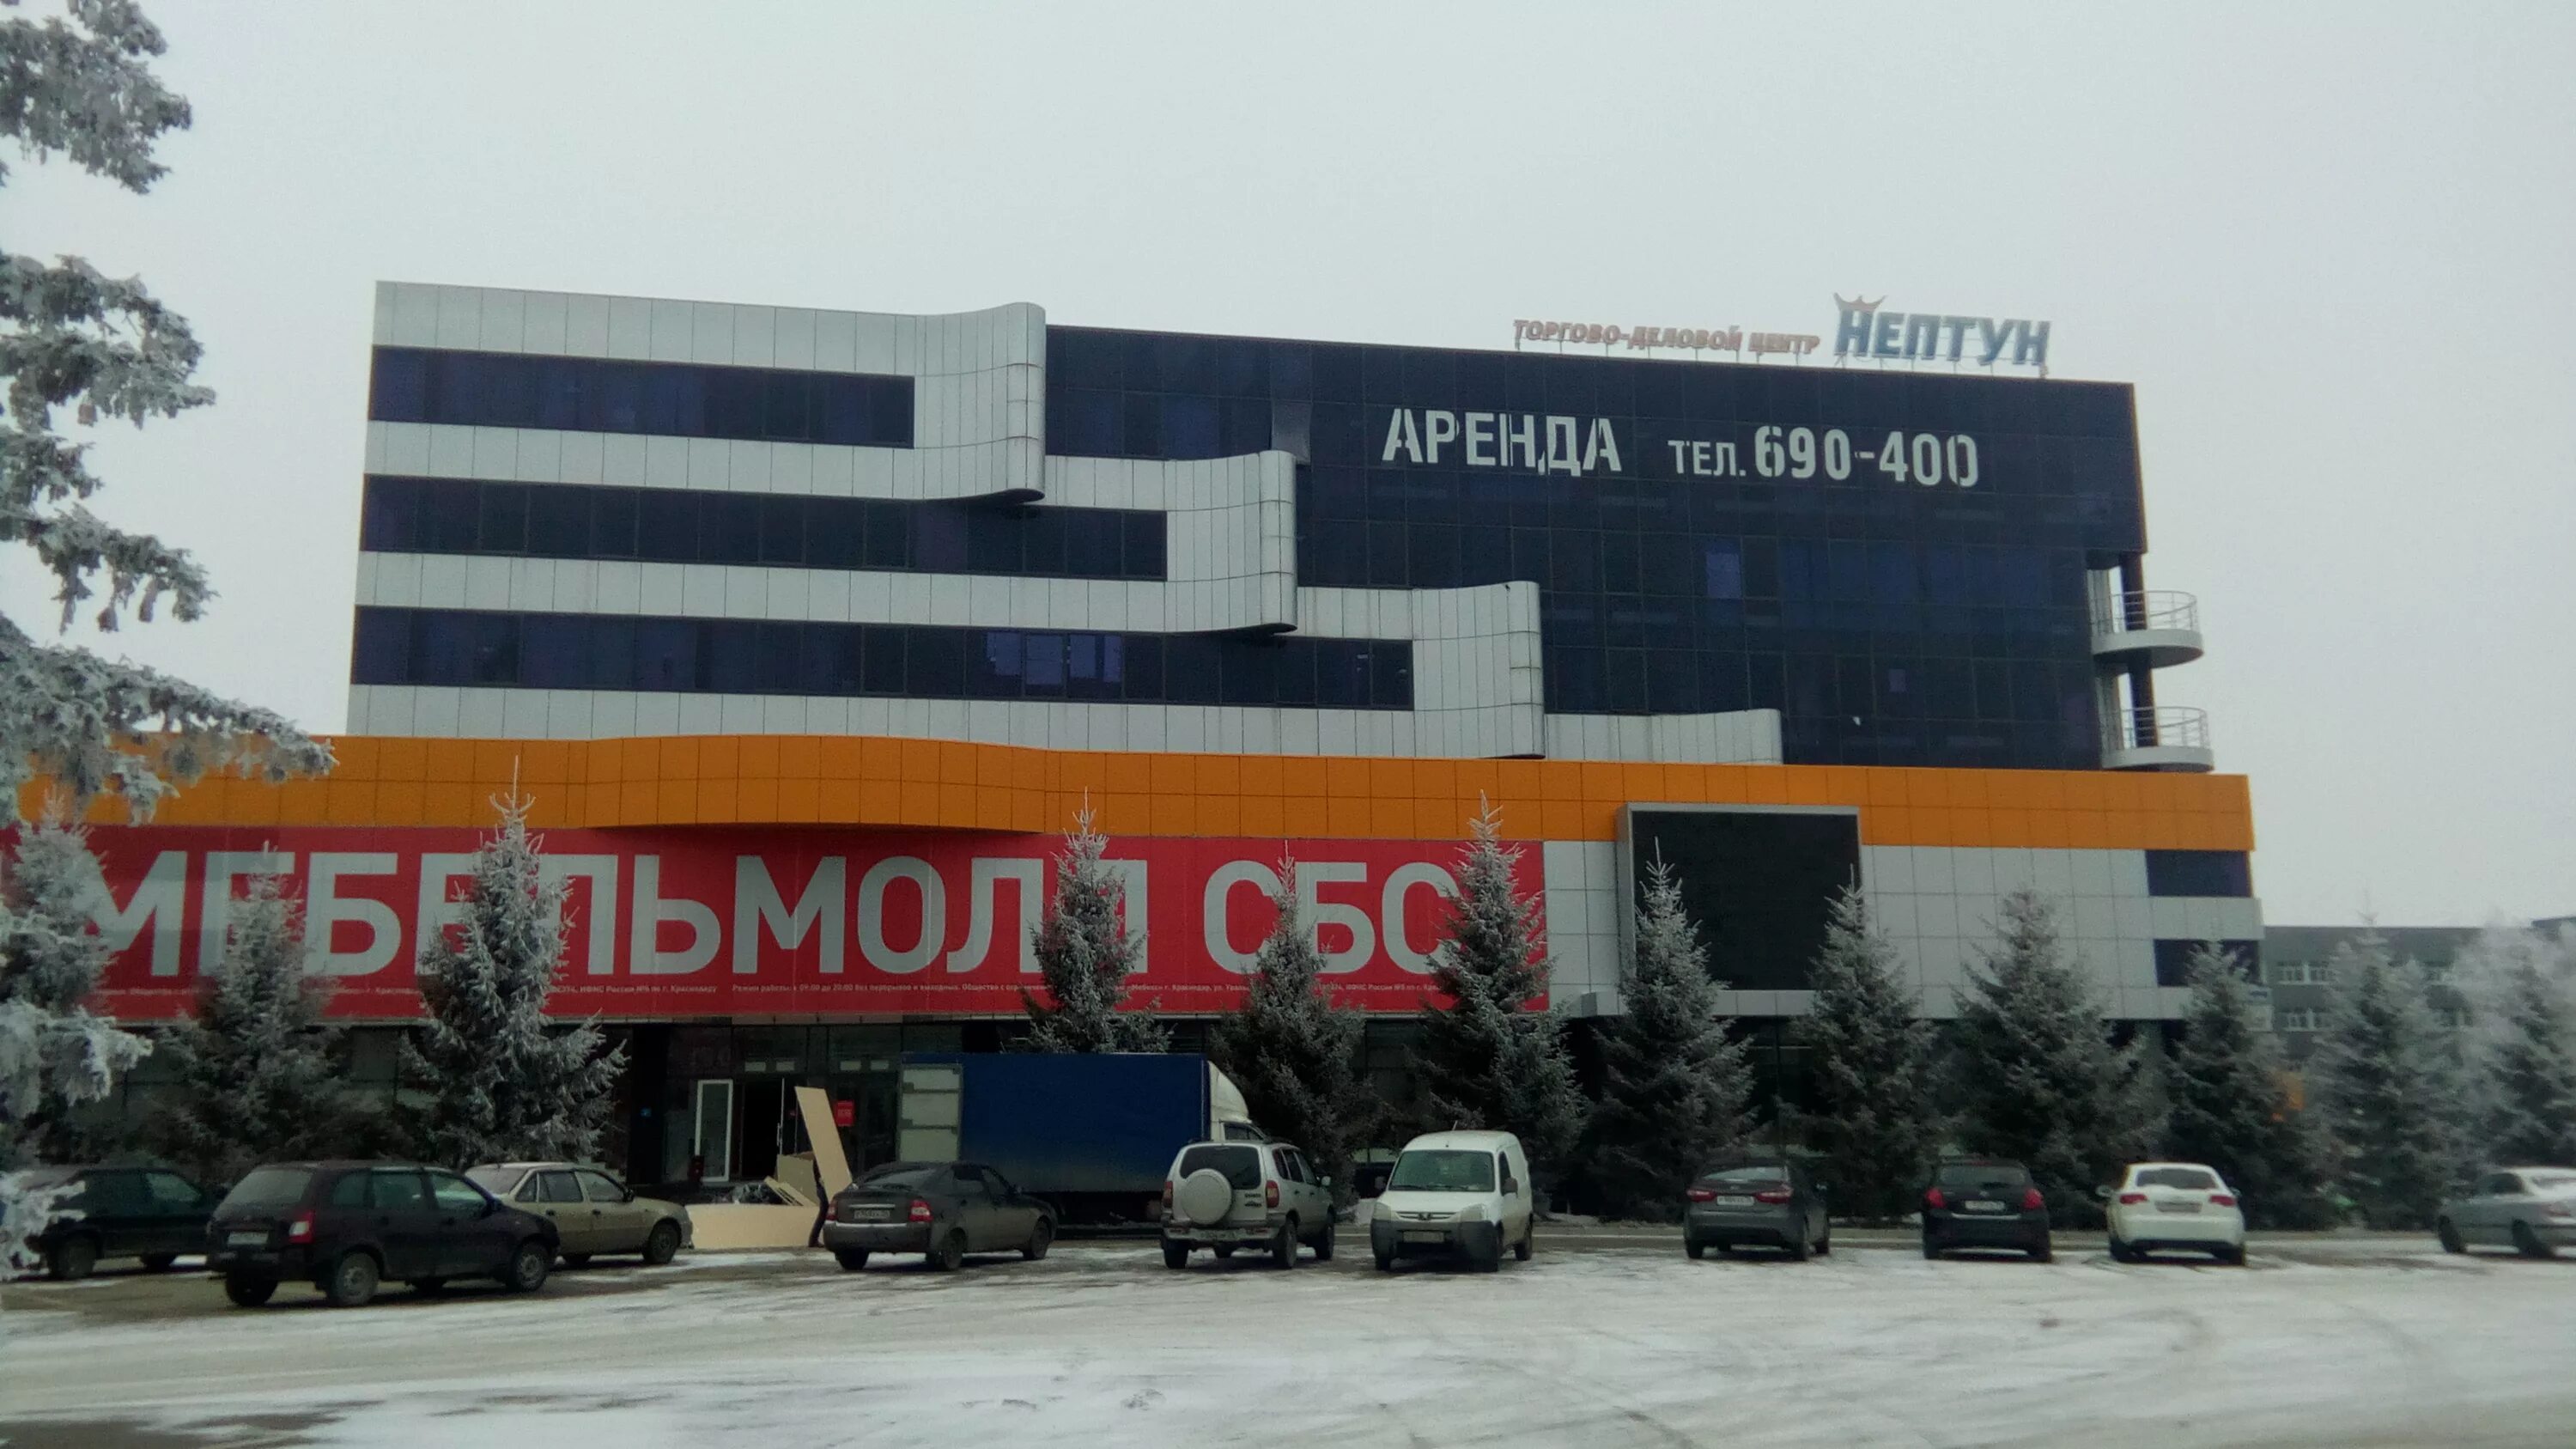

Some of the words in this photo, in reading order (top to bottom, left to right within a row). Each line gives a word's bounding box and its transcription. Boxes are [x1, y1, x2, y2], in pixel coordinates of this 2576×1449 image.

[1513, 319, 1744, 350] ТОРГОВО-ДЕЛОВОЙ
[1747, 332, 1821, 355] ЦЕНТР
[1834, 309, 2051, 366] НЕПТУН
[1382, 408, 1622, 477] АРЕНДА
[1668, 439, 1747, 477] ТЕЛ.
[1754, 425, 1978, 487] 690-400
